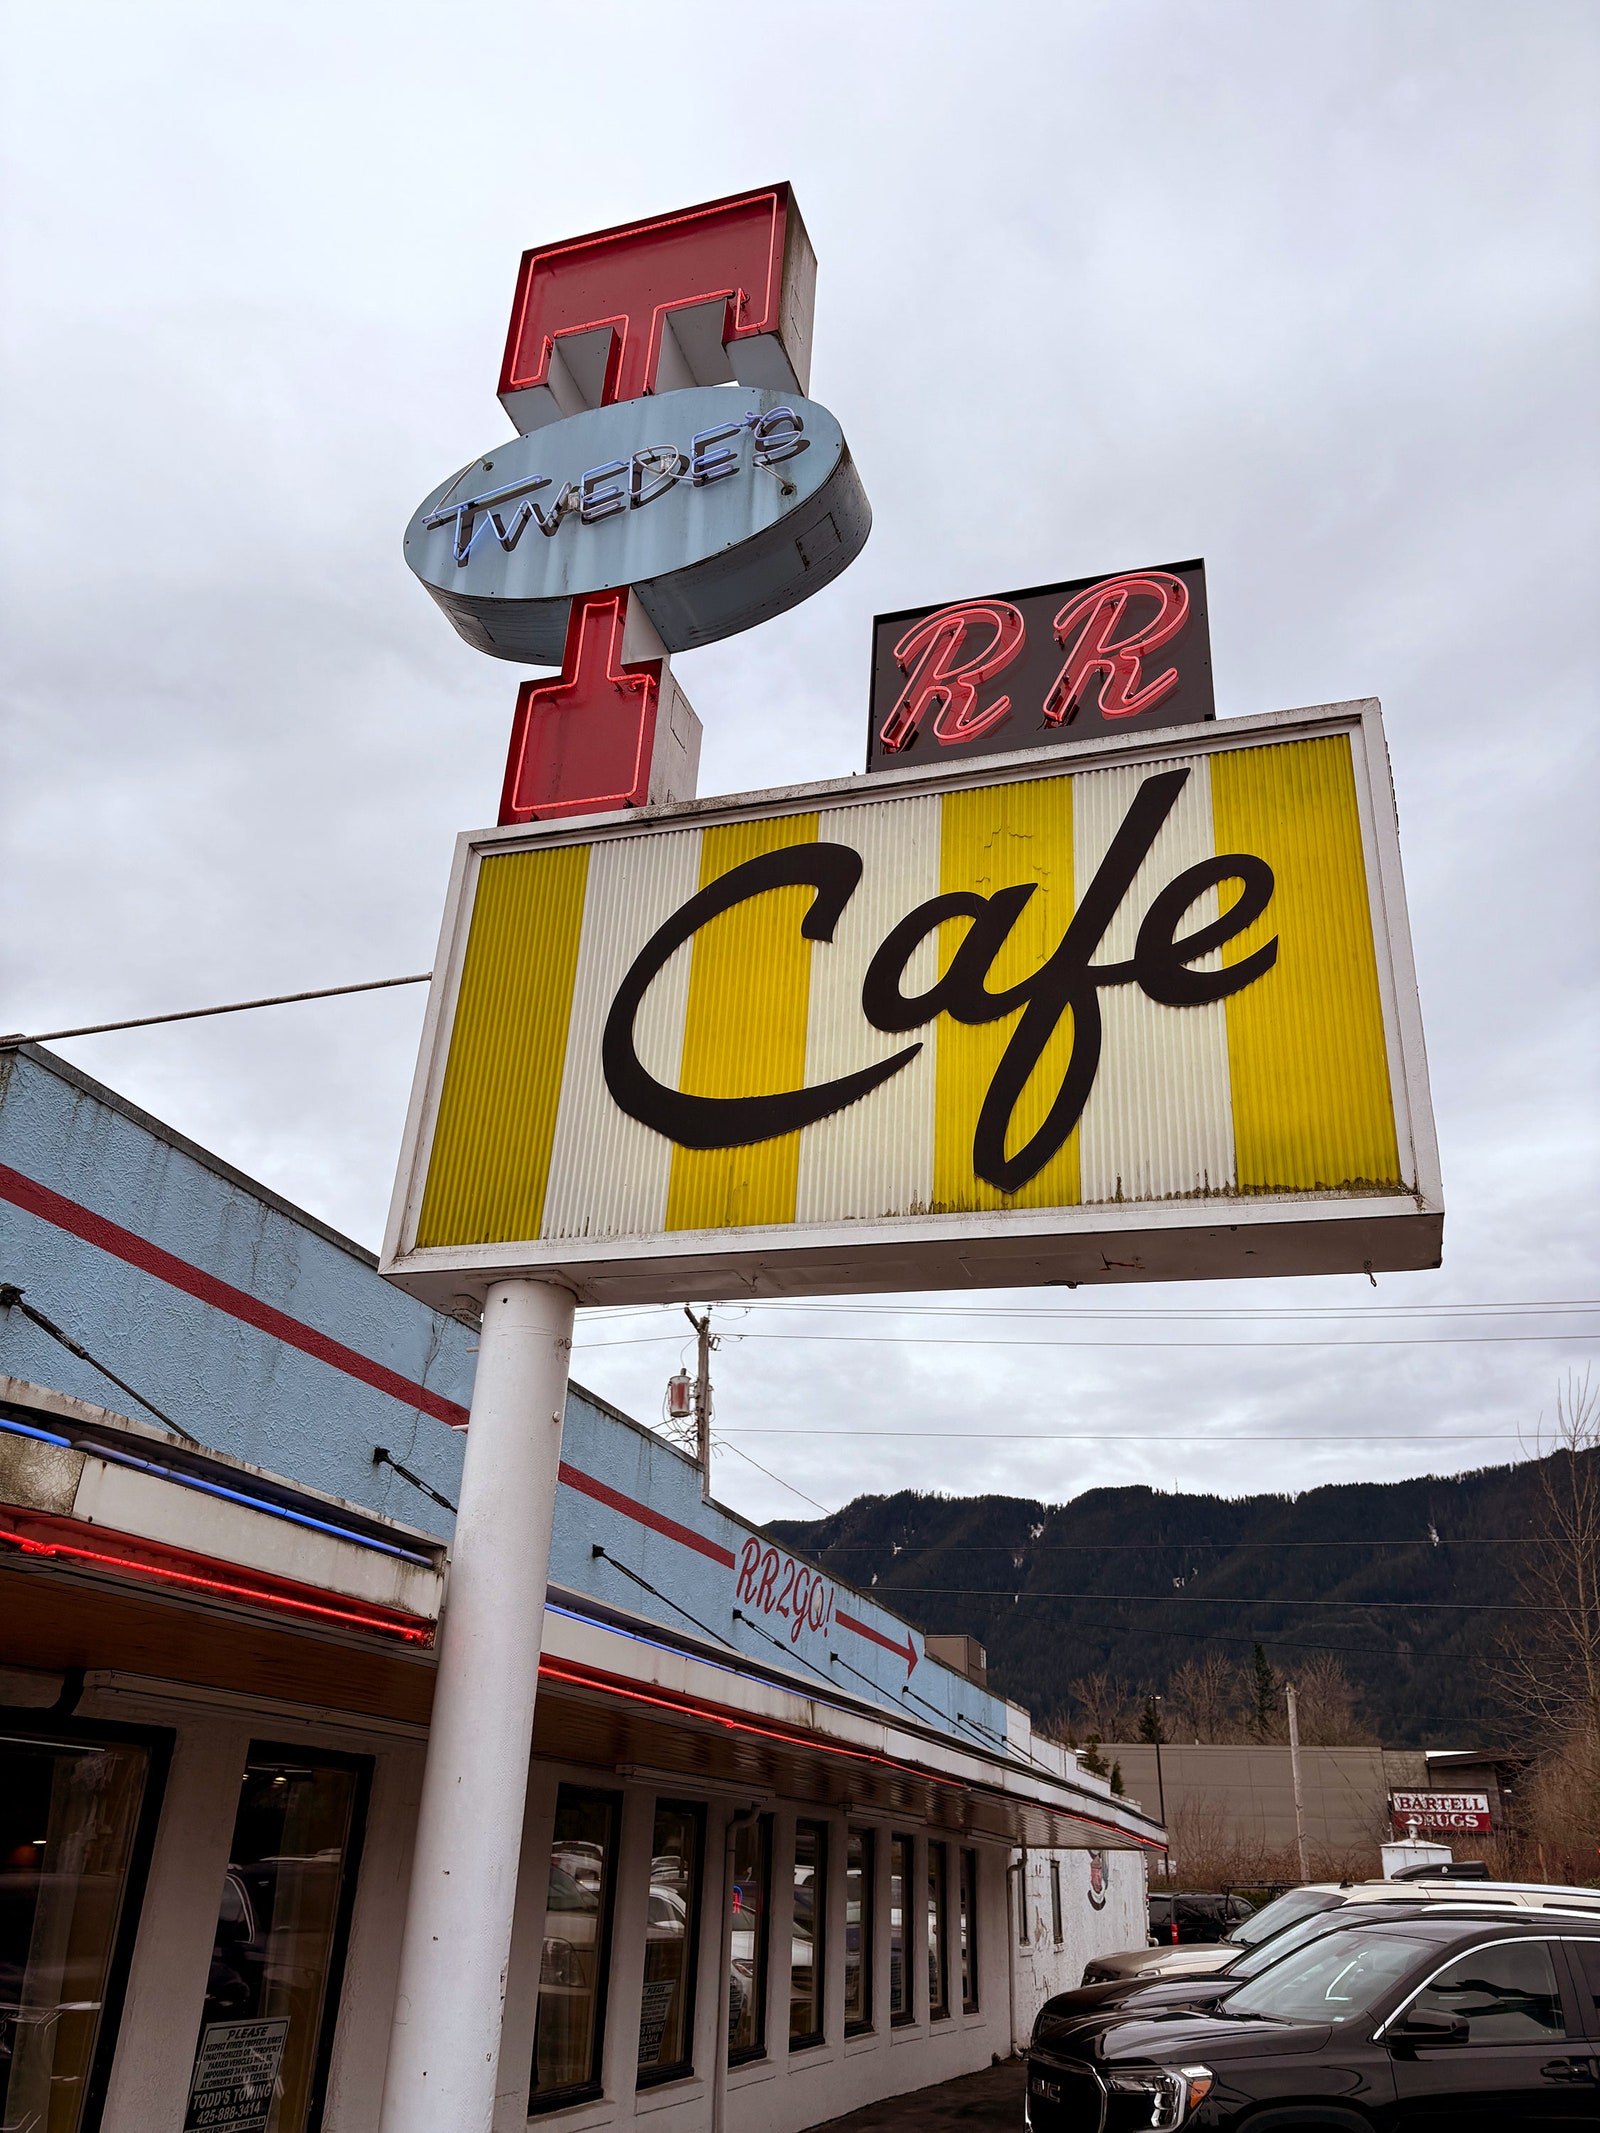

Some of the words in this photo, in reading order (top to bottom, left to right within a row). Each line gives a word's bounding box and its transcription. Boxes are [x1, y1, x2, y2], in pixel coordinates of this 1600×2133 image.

[422, 406, 811, 567] TWEDE'S
[602, 767, 1279, 1193] Cafe
[1400, 1797, 1484, 1811] BARTELL
[1407, 1814, 1479, 1828] DRUGS
[227, 2026, 269, 2039] PLEASE
[208, 2060, 228, 2069] PARKED
[228, 2058, 253, 2066] VEHICLES
[193, 2090, 231, 2110] TODD'S
[233, 2083, 272, 2103] TOWING
[1031, 2077, 1061, 2103] GMC
[196, 2102, 261, 2125] 425-888-3414
